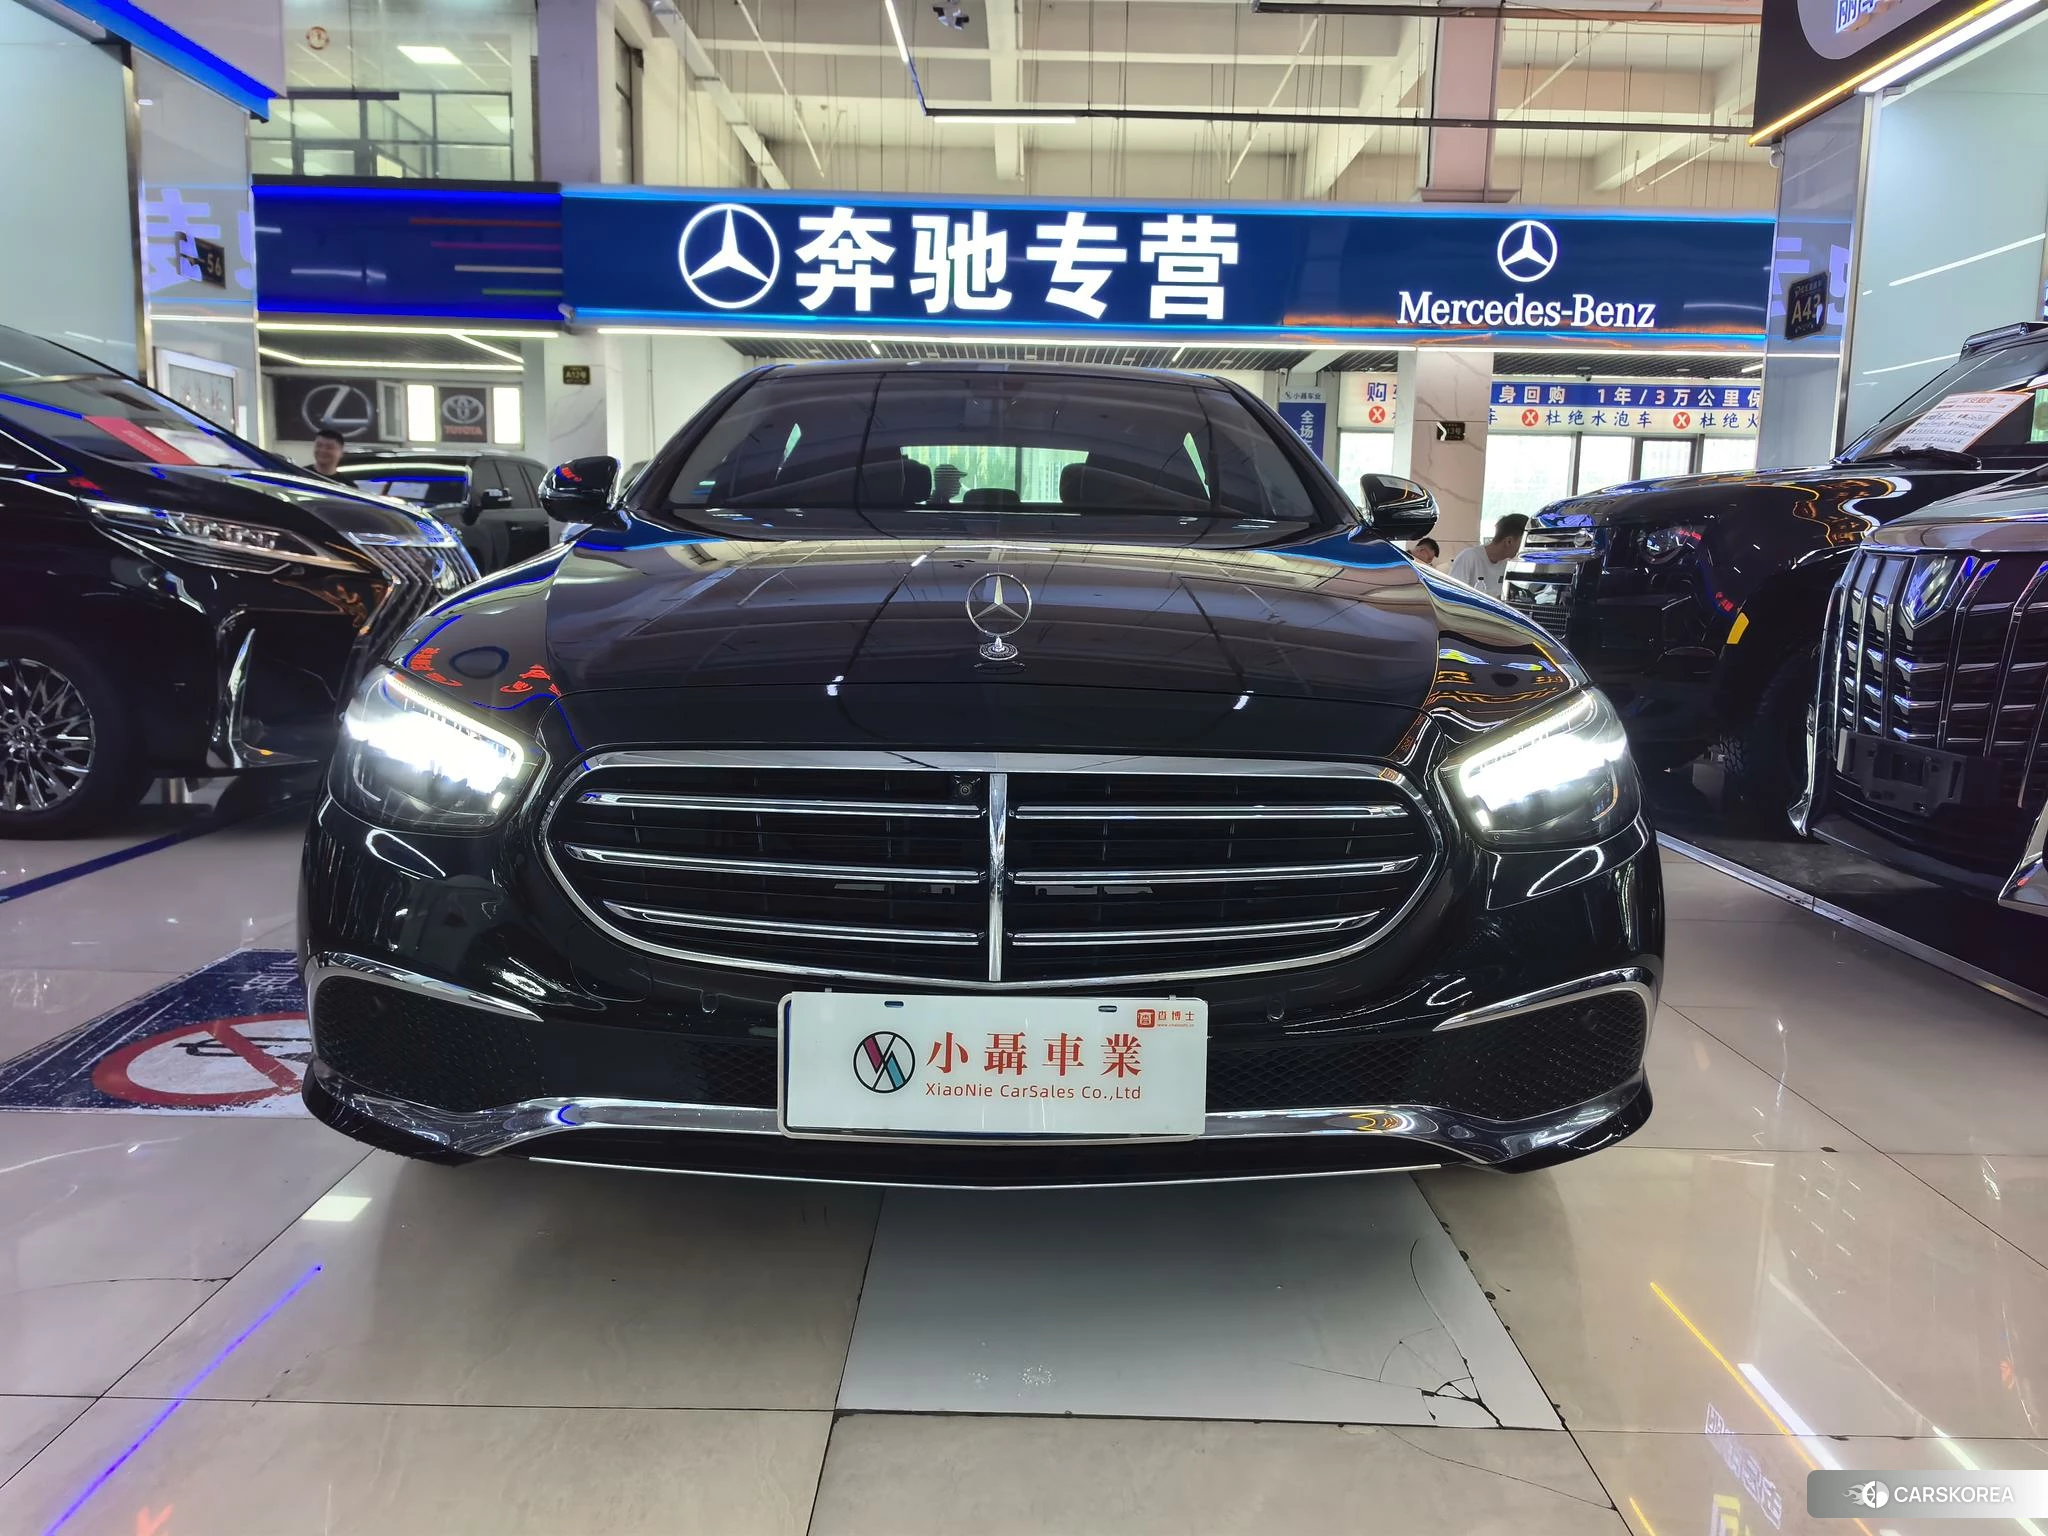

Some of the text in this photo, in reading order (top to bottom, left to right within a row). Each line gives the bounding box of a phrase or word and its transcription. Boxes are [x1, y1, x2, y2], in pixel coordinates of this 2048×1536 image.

[795, 207, 1239, 320] 奔驰专营
[1397, 290, 1656, 328] Mercedes-Benz
[1498, 385, 1566, 404] 身回购
[1545, 408, 1652, 429] 杜绝水泡车
[926, 1031, 1142, 1078] 小聶車業
[925, 1082, 1142, 1102] XiaoNie CarSales Co.,Ltd
